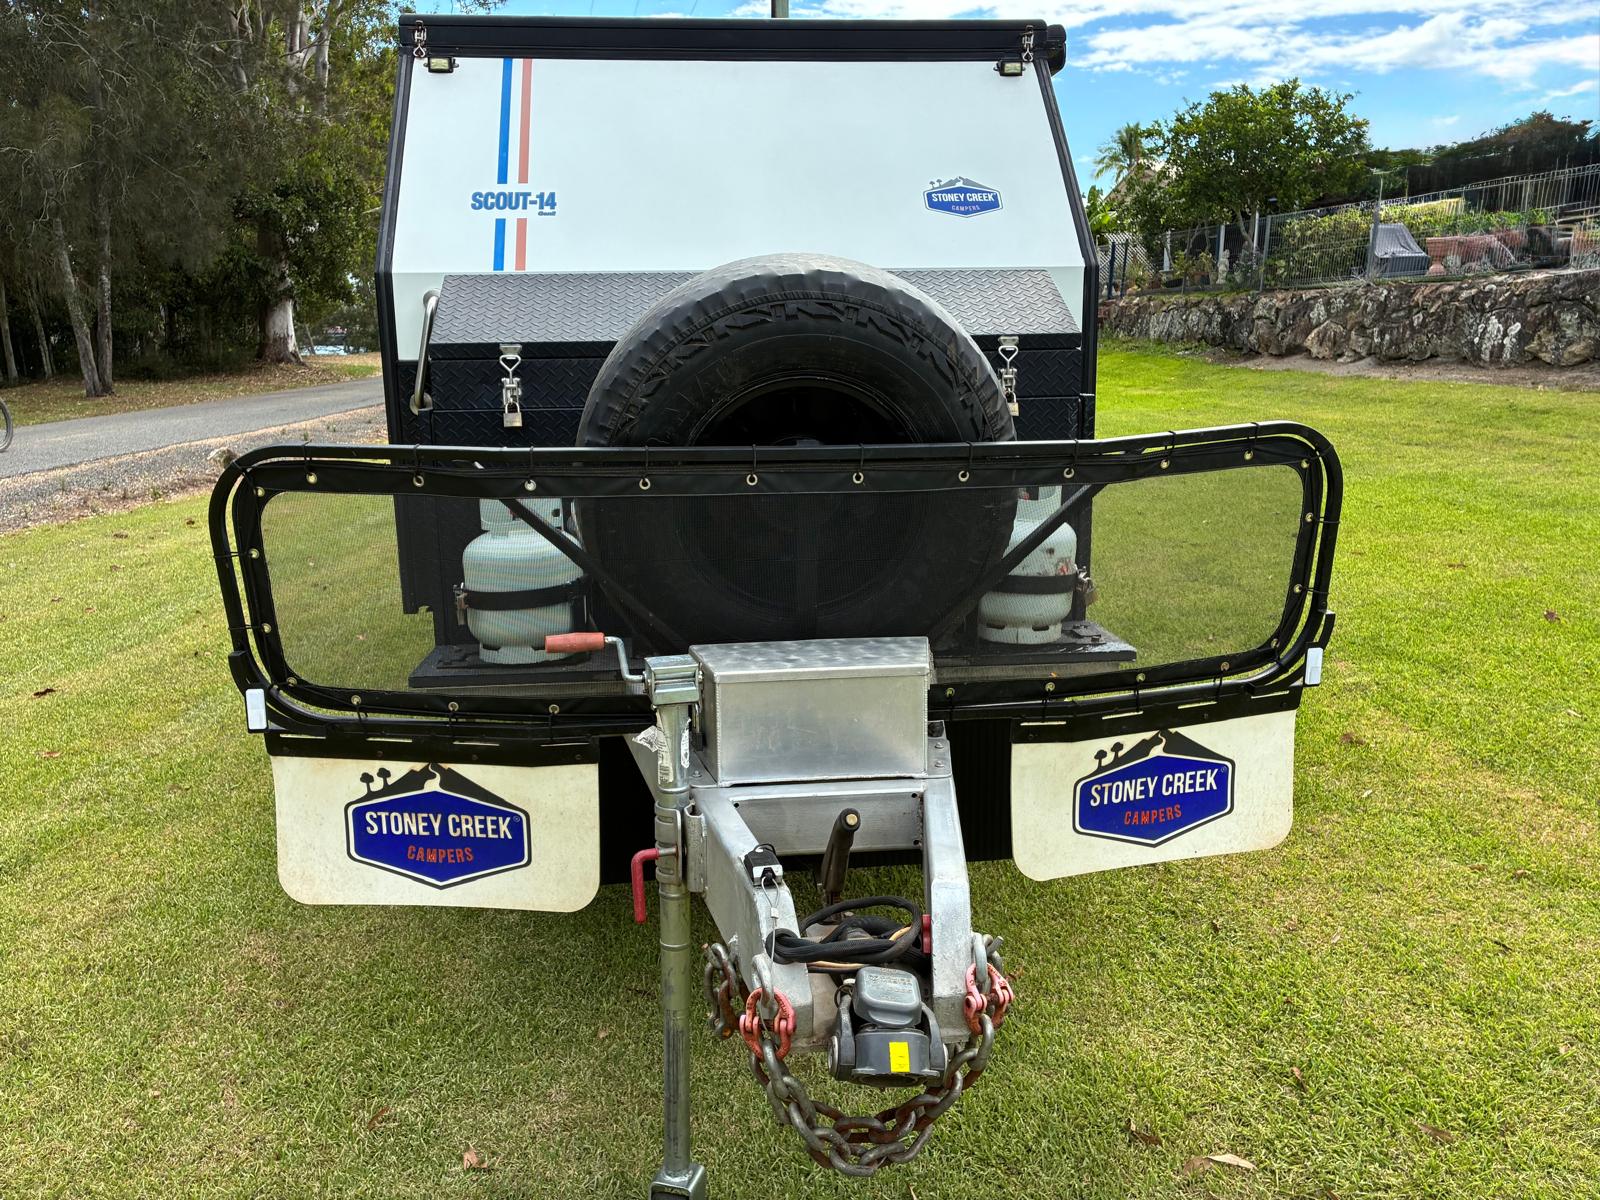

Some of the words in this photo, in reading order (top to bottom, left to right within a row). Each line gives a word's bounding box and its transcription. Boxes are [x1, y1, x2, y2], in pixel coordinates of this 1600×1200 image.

[470, 191, 557, 210] SCOUT-14
[931, 193, 965, 202] STONEY
[966, 193, 995, 202] CREEK
[1090, 776, 1158, 807] STONEY
[1161, 768, 1219, 796] CREEK
[1124, 804, 1182, 825] CAMPERS
[365, 811, 442, 836] STONEY
[447, 814, 513, 839] CREEK
[407, 845, 474, 864] CAMPERS
